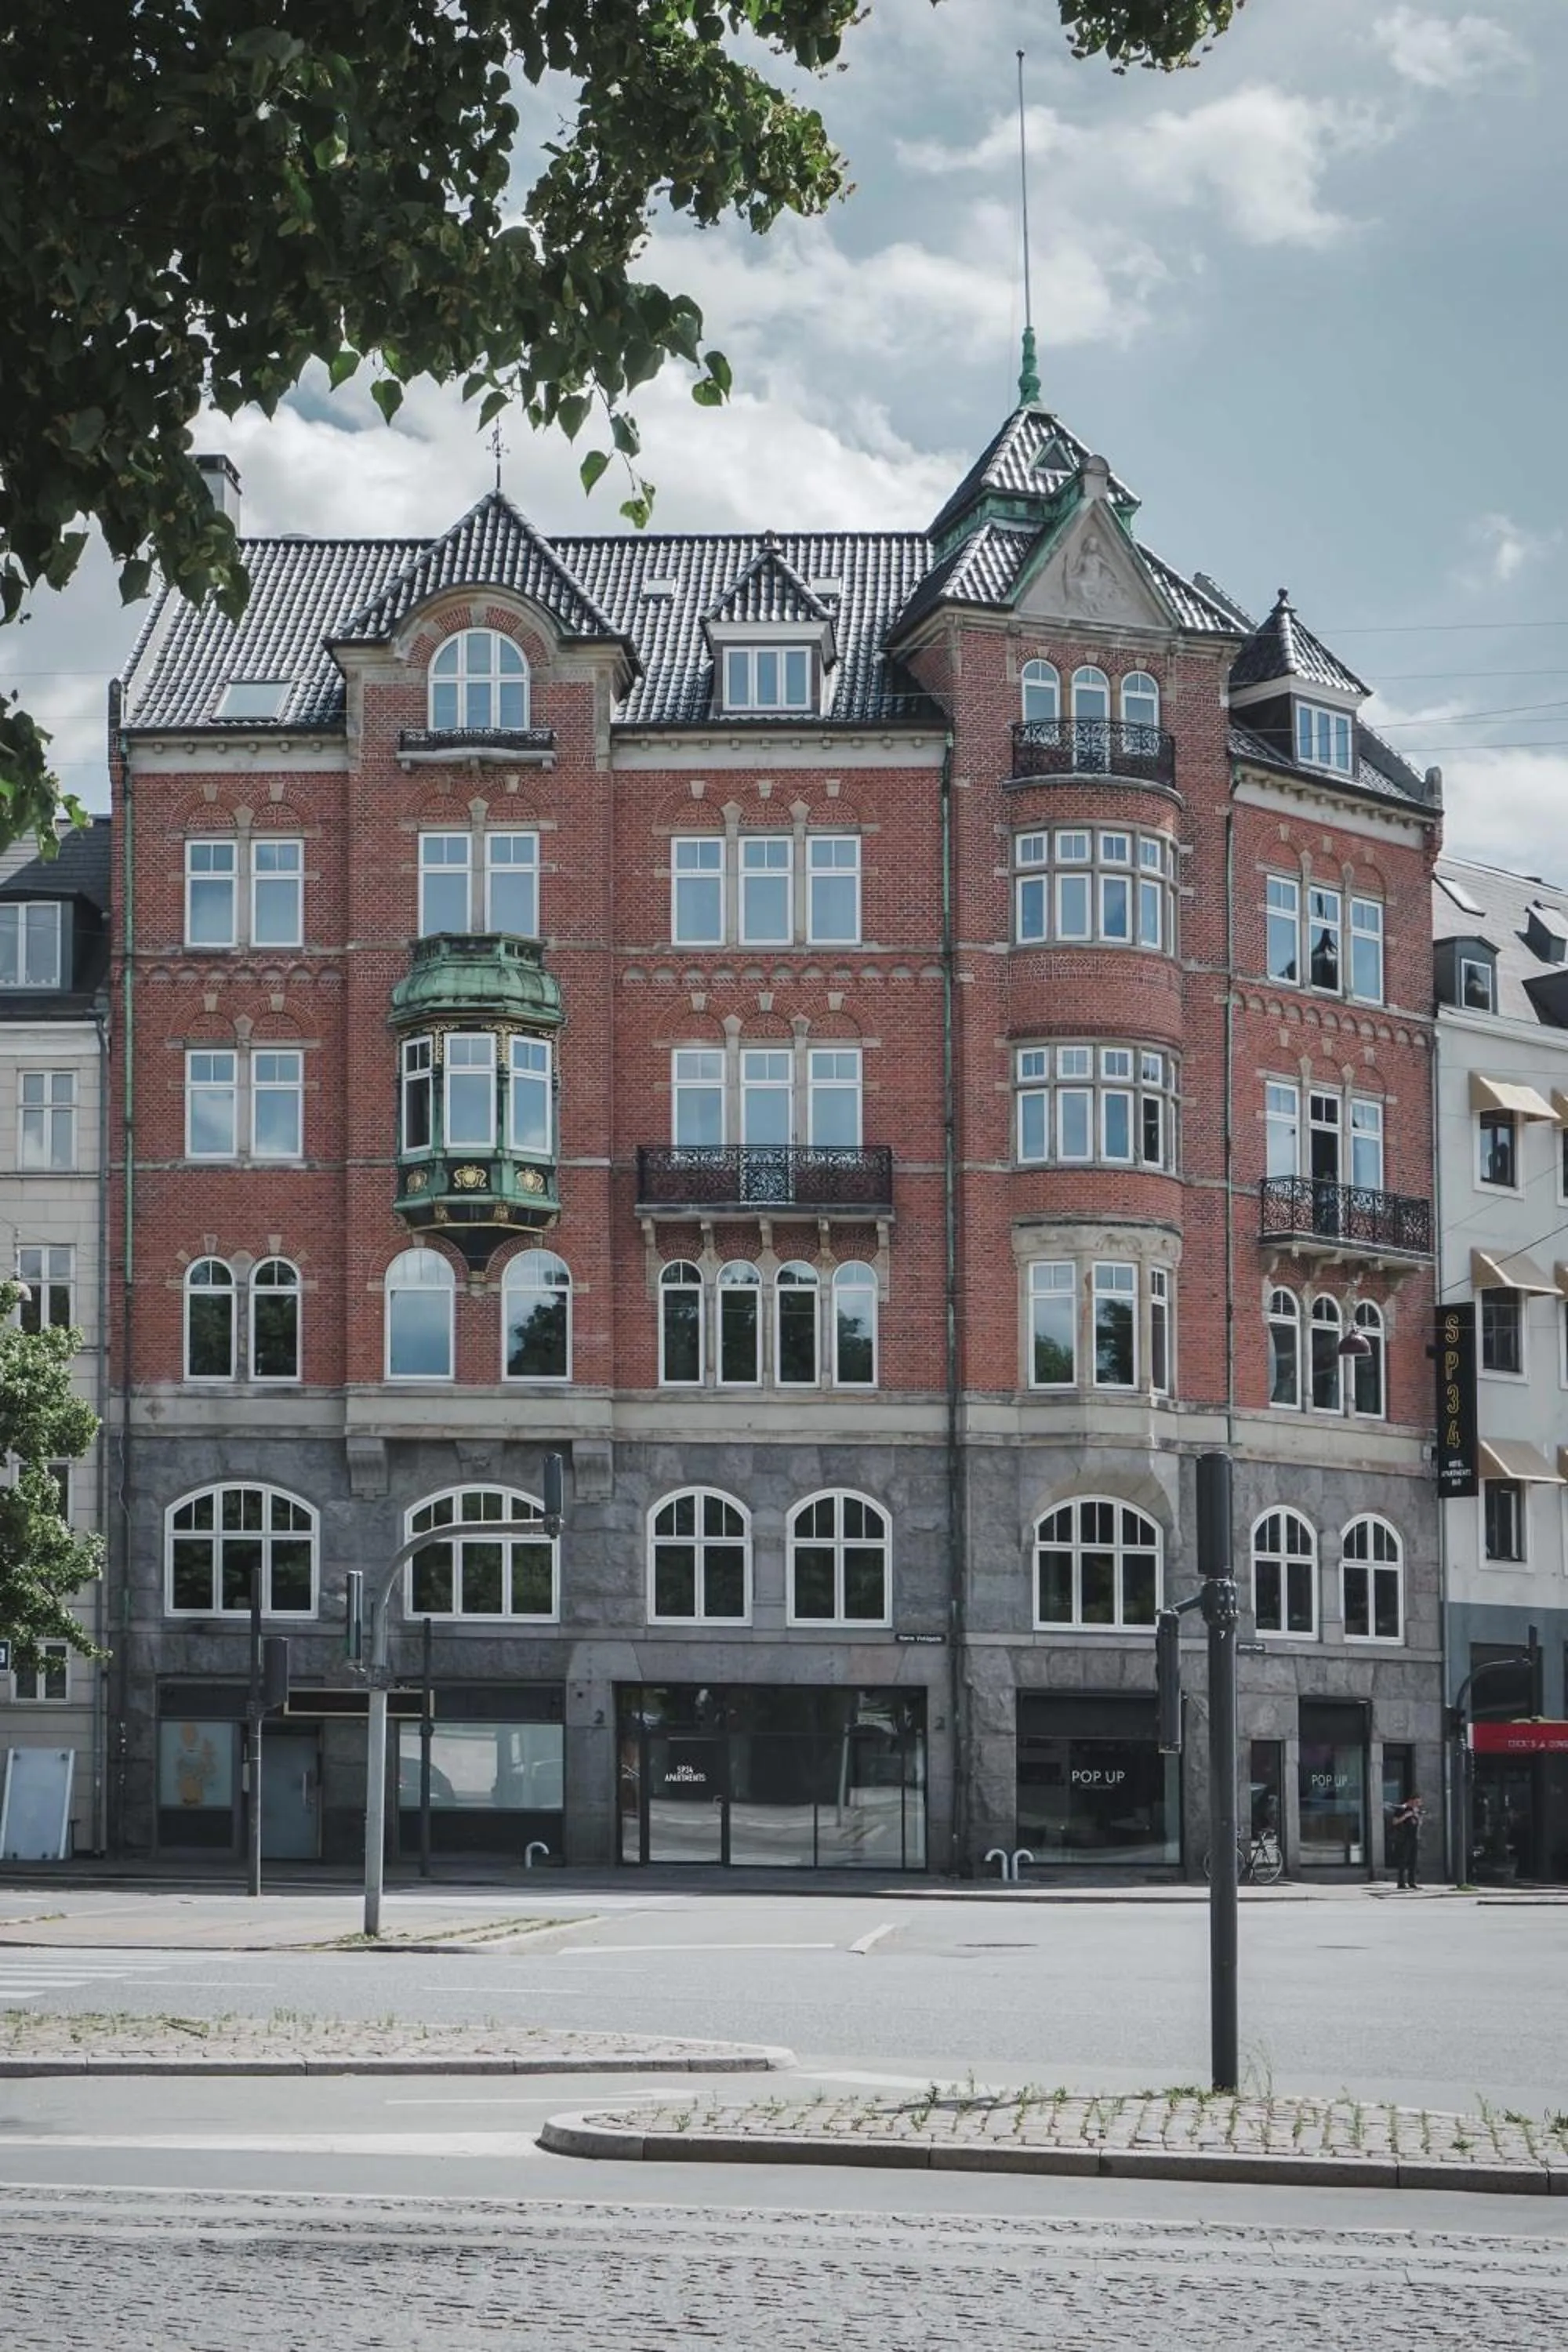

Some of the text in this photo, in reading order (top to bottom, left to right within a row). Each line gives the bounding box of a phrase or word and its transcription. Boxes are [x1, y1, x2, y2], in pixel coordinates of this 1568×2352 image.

[1445, 1314, 1460, 1449] SP34
[664, 1773, 706, 1781] APARTMENTS
[1072, 1769, 1125, 1784] POP UP
[1312, 1774, 1348, 1788] POP UP
